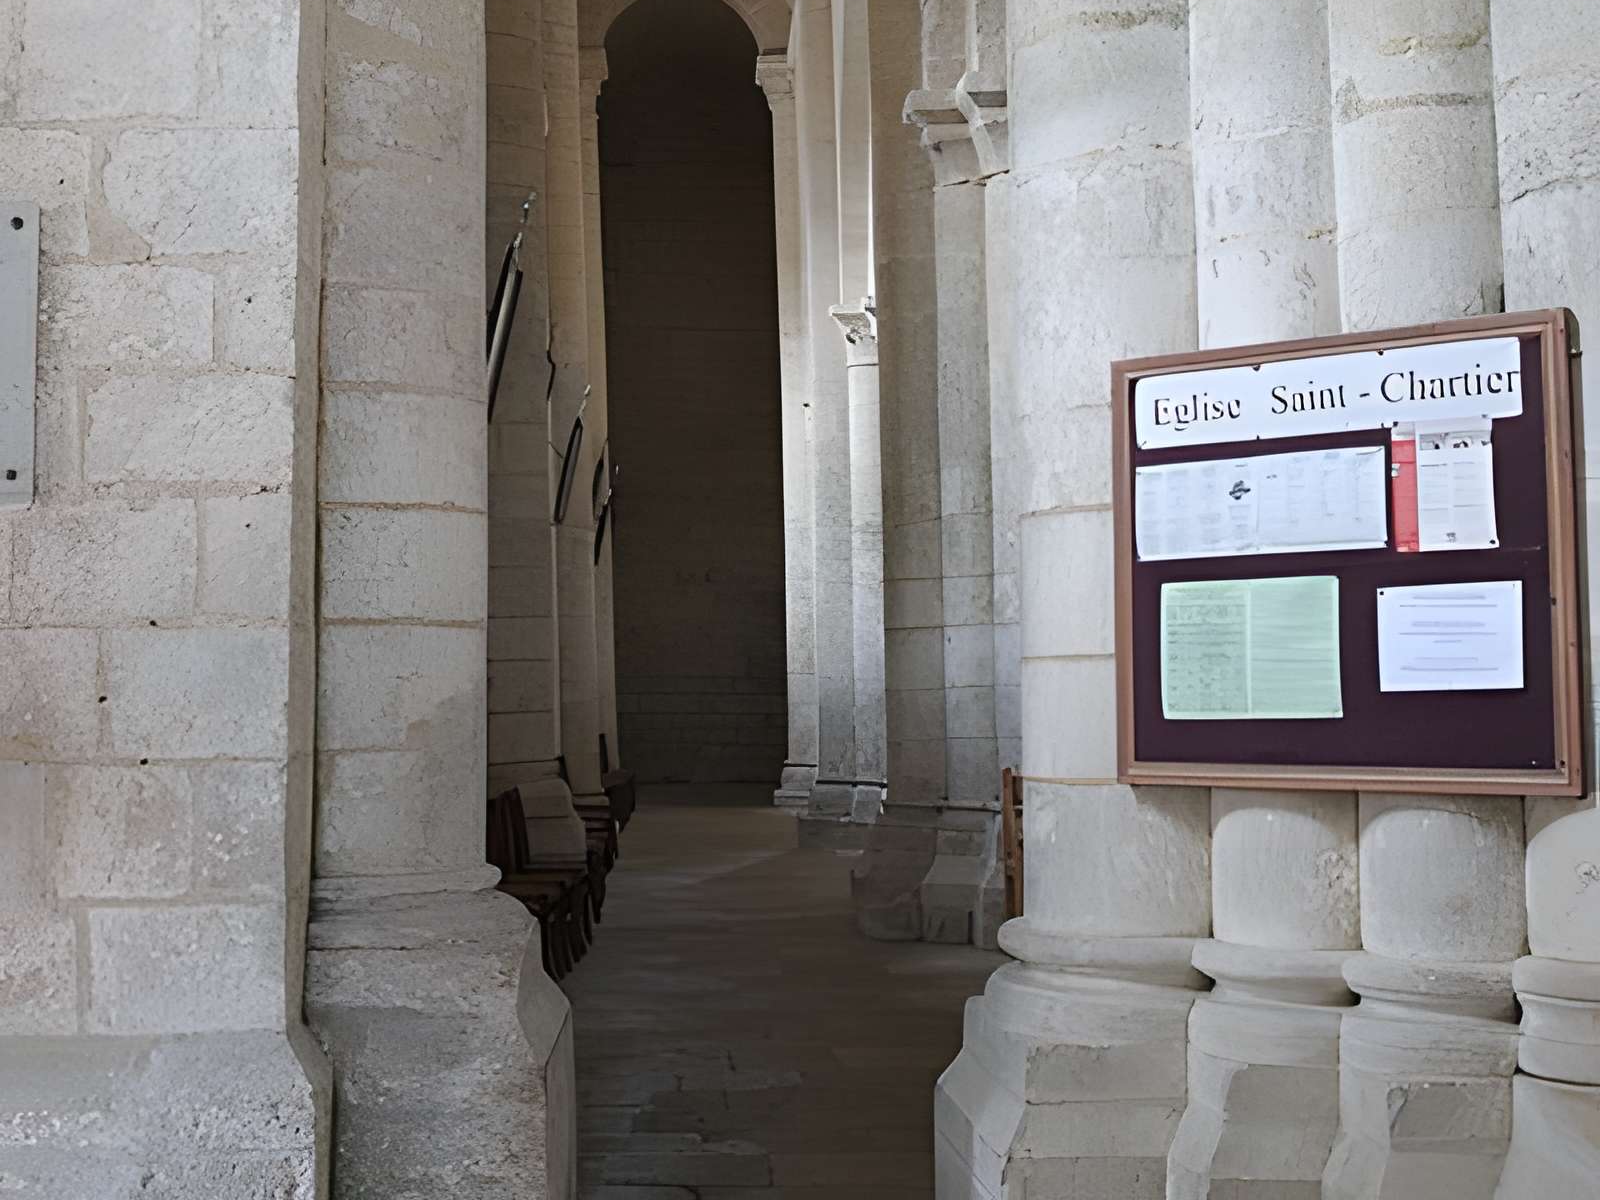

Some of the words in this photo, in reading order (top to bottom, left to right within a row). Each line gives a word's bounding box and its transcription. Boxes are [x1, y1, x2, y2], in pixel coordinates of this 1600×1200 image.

[1154, 392, 1241, 432] Eglise
[1271, 380, 1346, 415] Saint
[1380, 363, 1520, 403] Chartier
